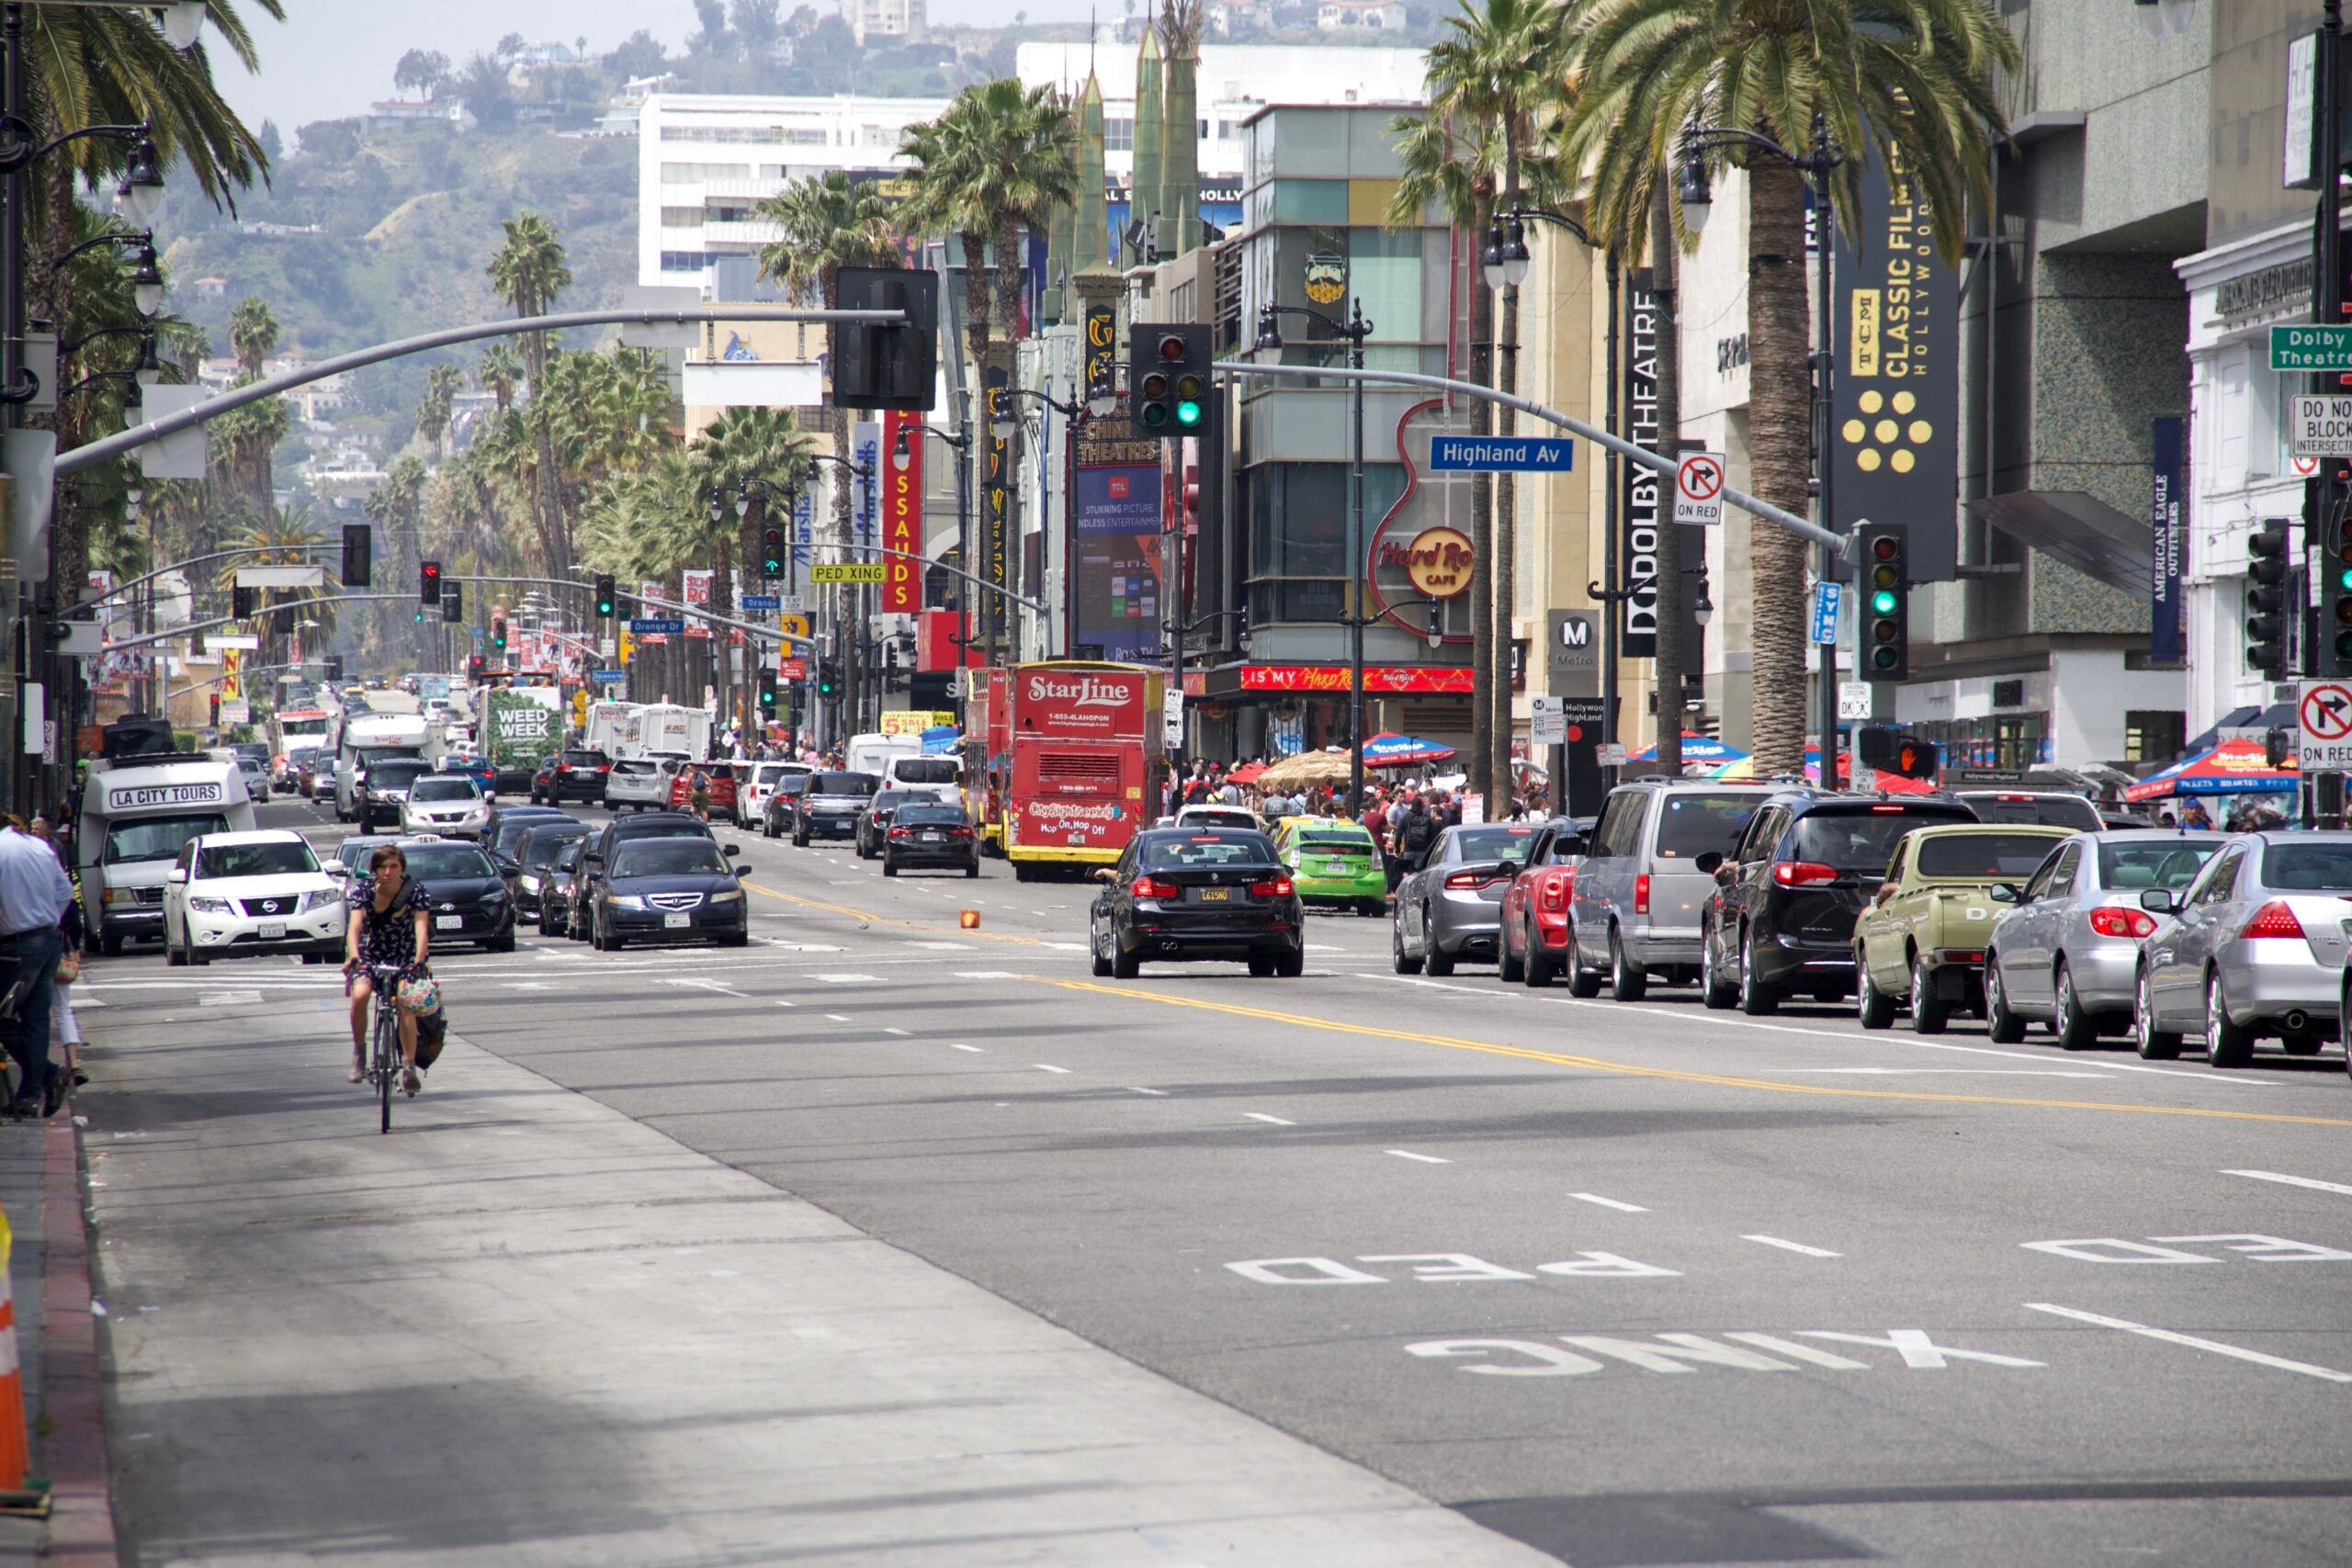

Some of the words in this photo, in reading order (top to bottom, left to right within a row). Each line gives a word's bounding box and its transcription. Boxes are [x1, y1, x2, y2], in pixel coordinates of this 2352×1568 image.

[1198, 189, 1243, 201] HOLLY
[1889, 185, 1914, 250] FILM
[1885, 258, 1911, 378] CLASSIC
[1859, 296, 1872, 369] TCM
[2290, 331, 2346, 348] Dolby
[2278, 351, 2352, 366] Theatre
[2303, 400, 2324, 418] DO
[2332, 400, 2352, 418] NO
[1085, 421, 1133, 440] CHINE
[2307, 421, 2352, 438] BLOCK
[1079, 440, 1158, 462] THEATRES
[2297, 440, 2352, 452] INTERSECTI
[1442, 443, 1526, 467] Highland
[1536, 446, 1560, 463] Av
[1112, 482, 1126, 491] TCL
[2154, 474, 2168, 521] EAGLE
[1086, 504, 1122, 514] STUNNING
[1123, 503, 1155, 513] PICTURE
[1678, 504, 1694, 516] ON
[1696, 506, 1718, 518] RED
[794, 492, 811, 568] Marsha
[1078, 518, 1106, 528] NDLESS
[1106, 516, 1161, 527] ENTERTAINMEN
[894, 464, 910, 604] SSAUDS
[1380, 542, 1442, 566] Hard
[1442, 542, 1472, 571] Ro
[2154, 526, 2166, 603] AMERICAN
[686, 575, 709, 587] SCH
[816, 568, 843, 579] PED
[850, 568, 882, 579] XING
[1425, 574, 1456, 586] CAFE
[686, 588, 709, 604] RO
[1822, 587, 1838, 640] SYNC
[635, 621, 666, 632] Orange
[669, 622, 680, 631] Dr
[1564, 622, 1587, 645] M
[1557, 655, 1594, 666] Metro
[1251, 671, 1265, 682] IS
[1272, 671, 1296, 682] MY
[1303, 667, 1339, 689] HARD
[1338, 667, 1374, 690] ROK
[1027, 676, 1133, 707] StarLine
[498, 709, 548, 723] WEED
[1566, 704, 1604, 715] Hollywoo
[1841, 702, 1853, 715] OK
[1566, 713, 1602, 723] Highland
[499, 723, 548, 737] WEEK
[2303, 747, 2322, 761] ON
[116, 792, 133, 805] LA
[137, 789, 168, 804] CITY
[173, 785, 216, 801] TOURS
[1029, 802, 1114, 821] CitySightseeing
[1040, 823, 1057, 833] Hop
[1072, 820, 1090, 830] Hop
[1091, 825, 1106, 835] Off
[2018, 1233, 2352, 1266] ED
[1223, 1250, 1685, 1285] PED
[1404, 1328, 2048, 1376] XING
